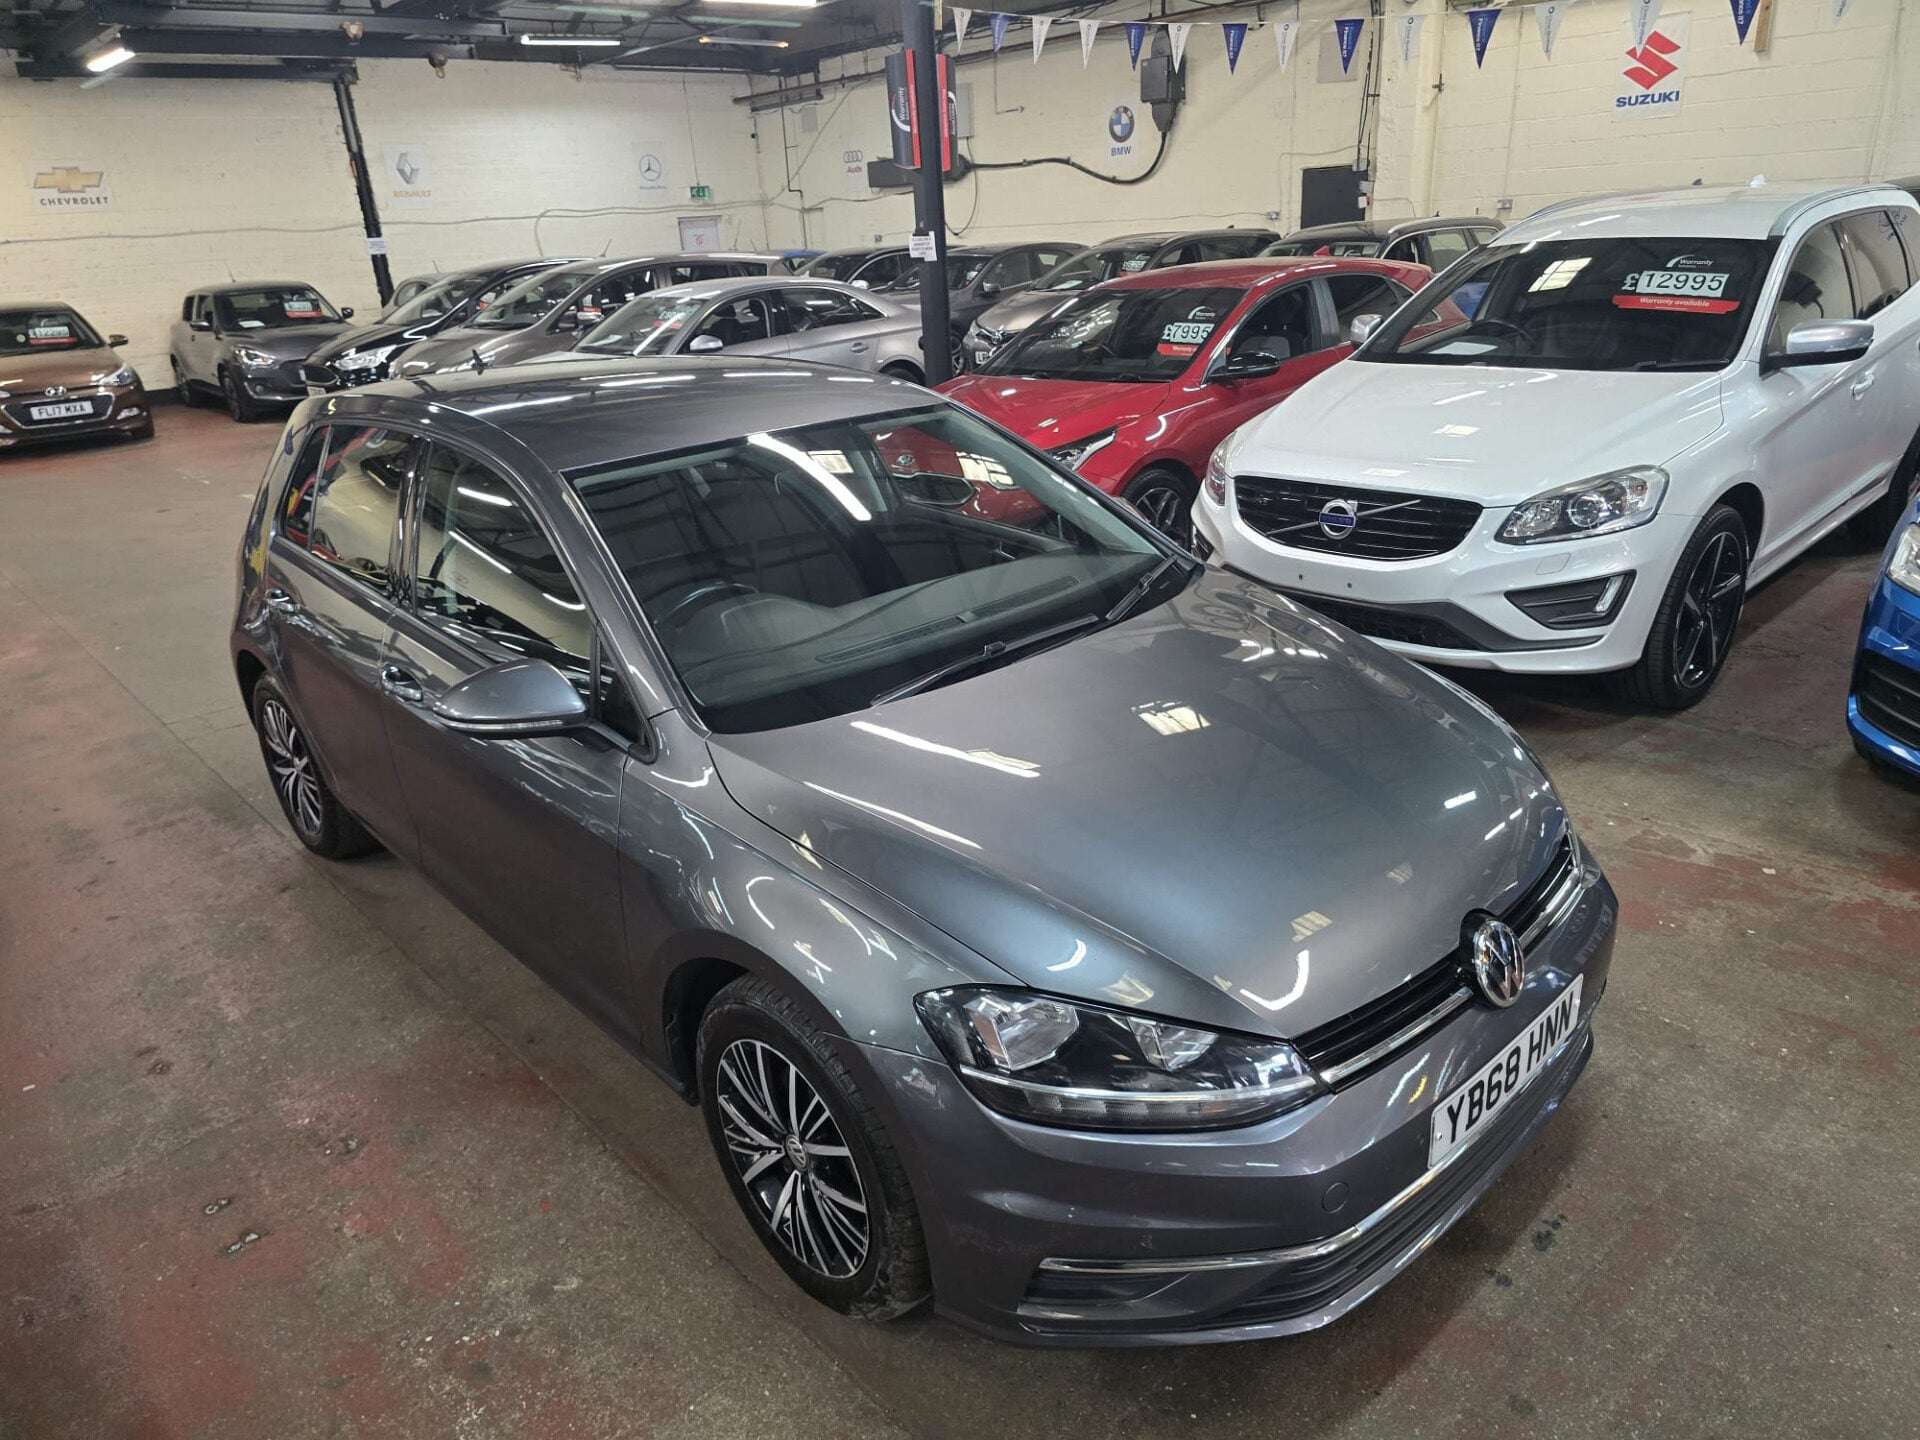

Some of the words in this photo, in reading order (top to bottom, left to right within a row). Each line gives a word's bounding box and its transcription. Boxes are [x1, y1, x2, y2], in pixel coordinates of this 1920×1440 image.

[1615, 90, 1680, 108] SUZUKI
[1110, 146, 1131, 156] BMW
[40, 196, 108, 206] CHEVROLET
[1621, 273, 1725, 291] £12995
[1447, 1046, 1522, 1144] YB68
[1526, 991, 1575, 1073] HNN
